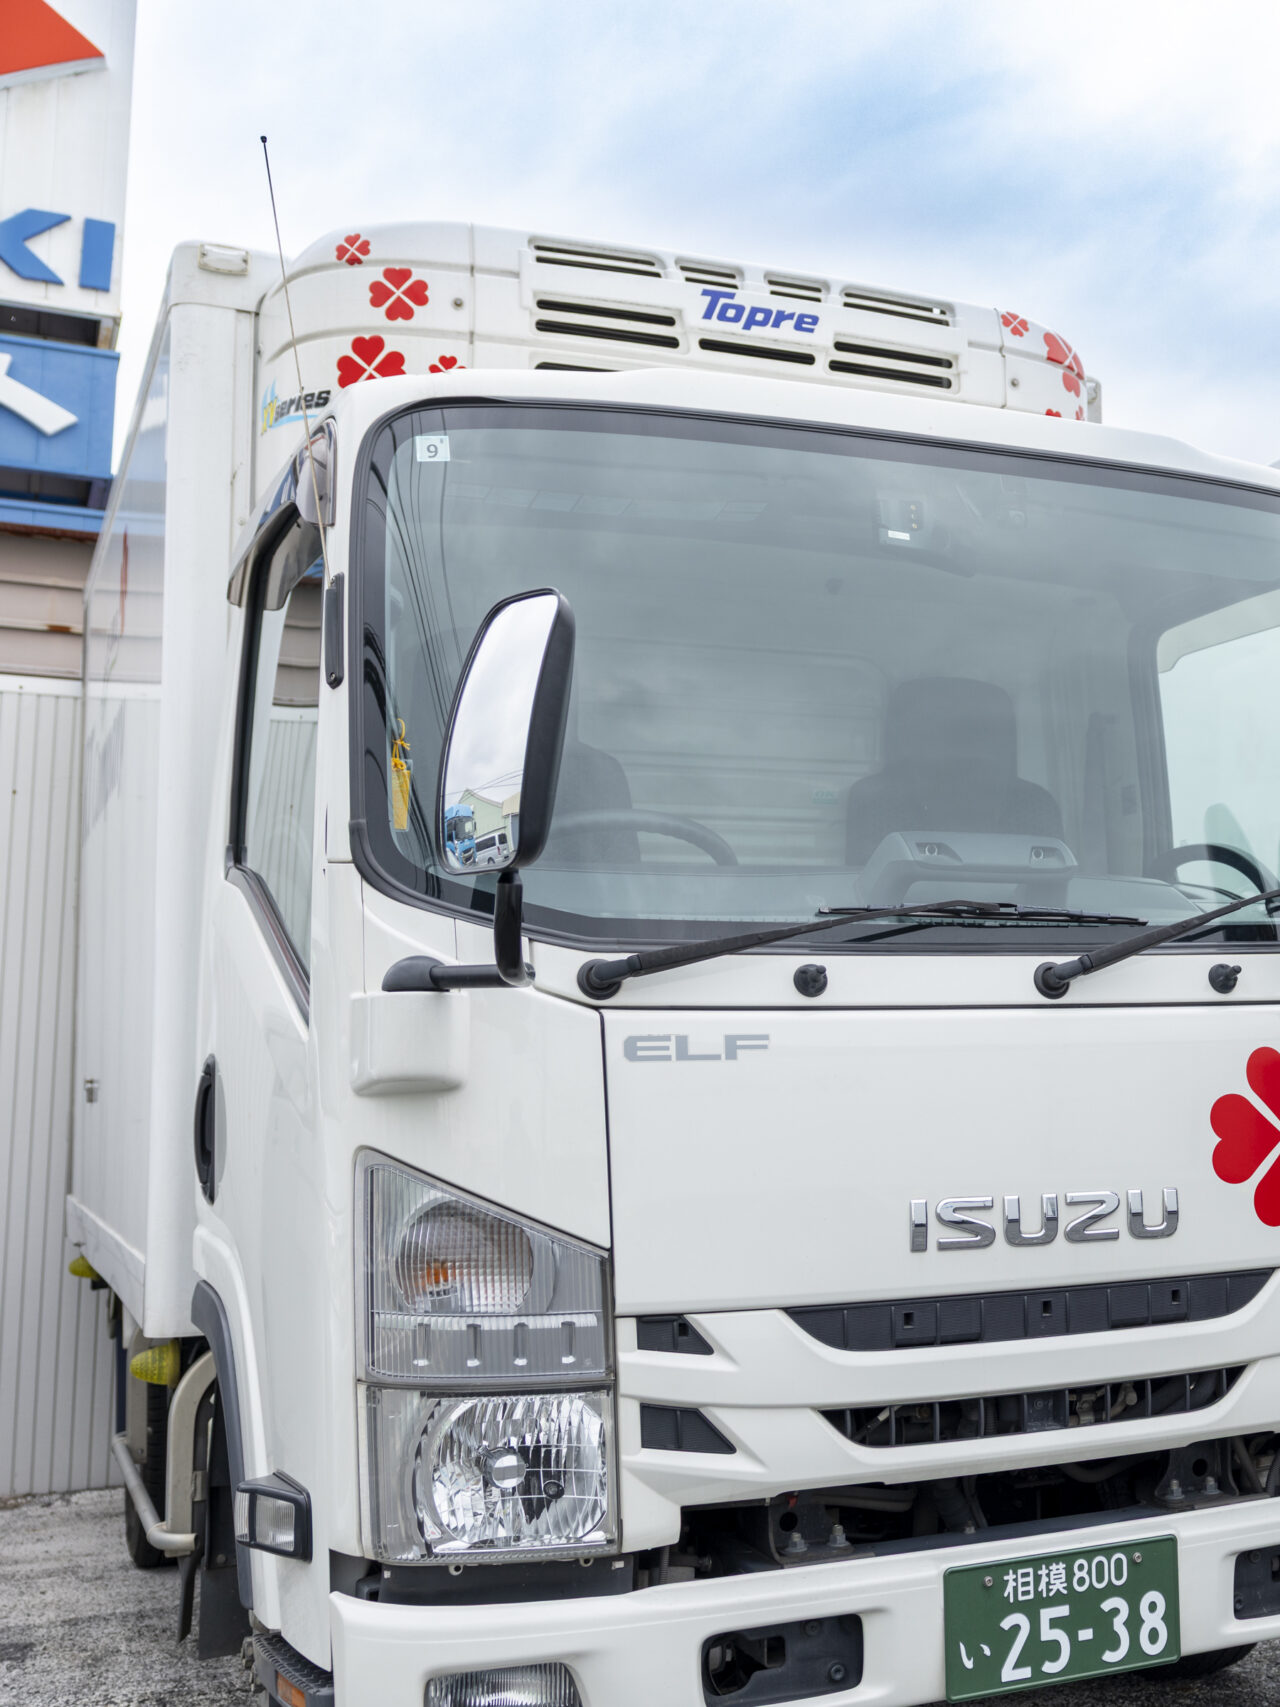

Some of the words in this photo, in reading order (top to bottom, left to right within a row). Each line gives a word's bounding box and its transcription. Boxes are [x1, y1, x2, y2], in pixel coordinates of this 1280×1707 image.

[701, 289, 819, 333] Topre
[426, 443, 439, 459] 9
[624, 1034, 770, 1062] ELF
[909, 1186, 1180, 1253] ISUZU
[959, 1640, 992, 1670] い
[1000, 1590, 1168, 1683] 25-38
